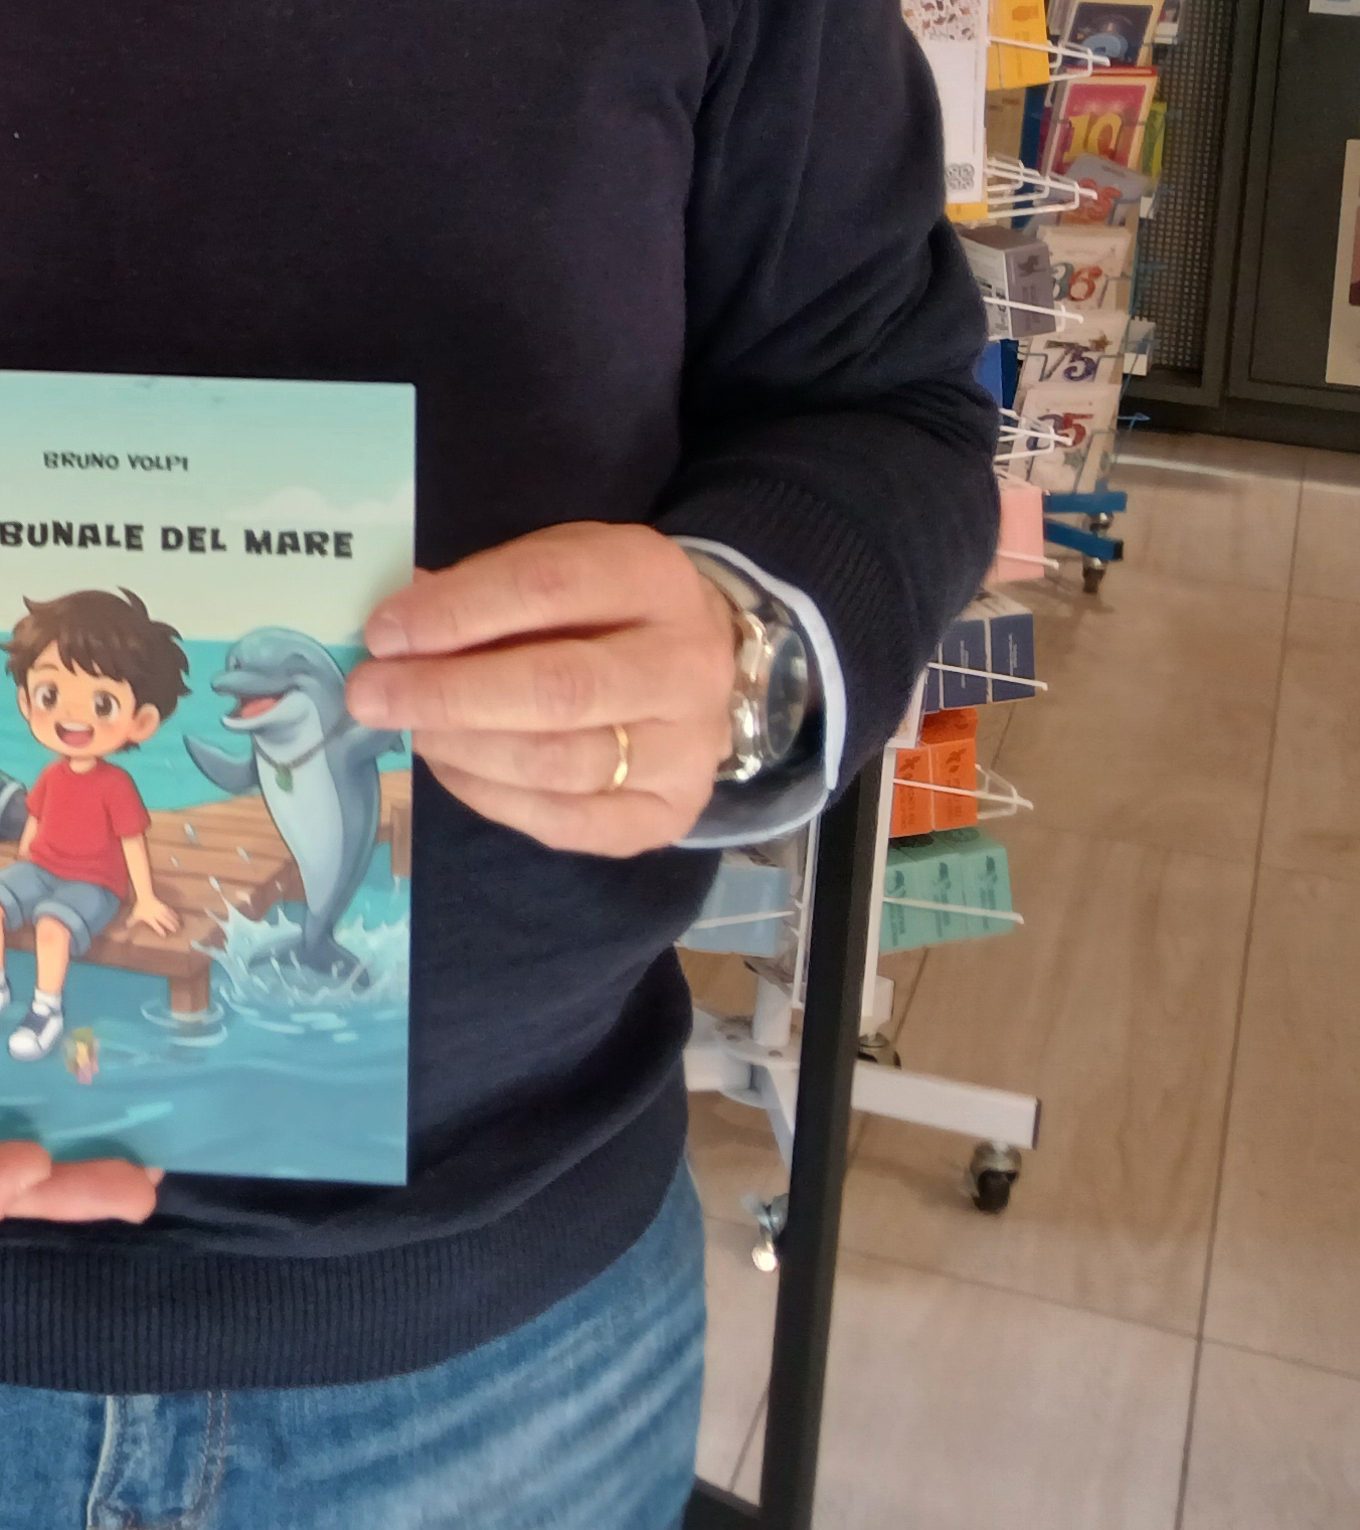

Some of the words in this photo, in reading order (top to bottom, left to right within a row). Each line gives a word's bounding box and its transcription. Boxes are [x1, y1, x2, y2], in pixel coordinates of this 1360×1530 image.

[43, 451, 119, 469] BRUNO
[127, 453, 189, 472] VOLPI
[160, 527, 226, 552] DEL
[243, 528, 353, 559] MARE
